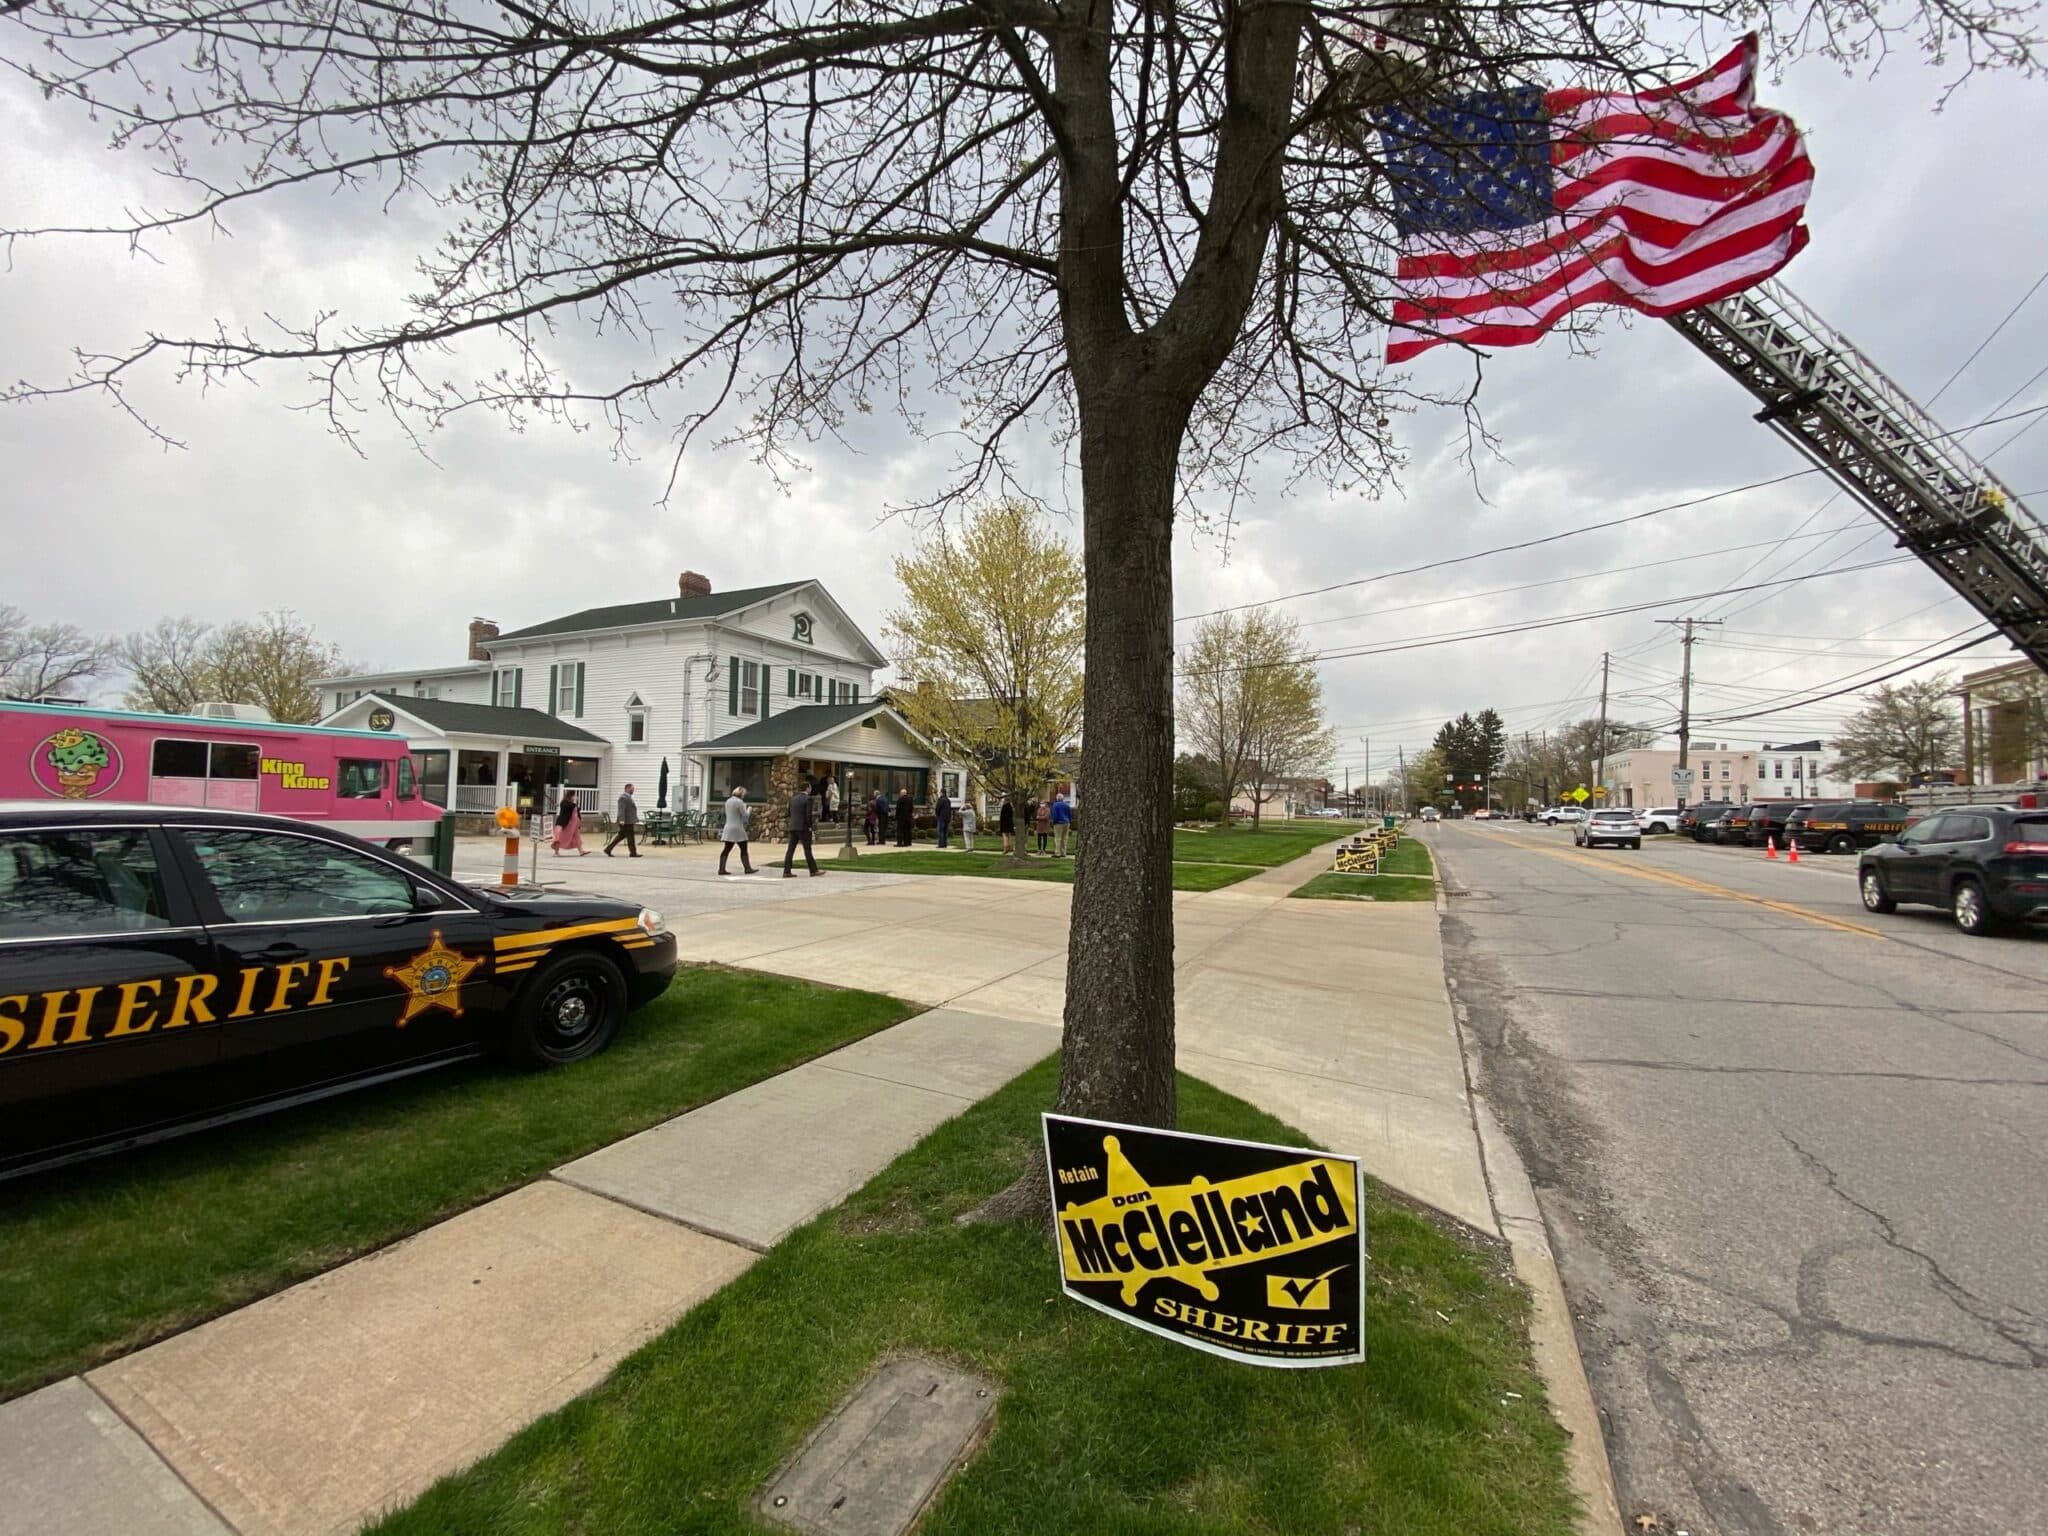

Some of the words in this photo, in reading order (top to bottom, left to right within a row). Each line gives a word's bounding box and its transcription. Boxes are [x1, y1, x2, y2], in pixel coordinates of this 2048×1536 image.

[261, 758, 305, 776] King
[282, 774, 329, 789] Kone
[0, 957, 350, 1051] SHERIFF
[1058, 1164, 1099, 1185] Retain
[1111, 1190, 1152, 1208] Dan
[1063, 1163, 1350, 1274] McClelland
[1153, 1297, 1347, 1345] SHERIFF
